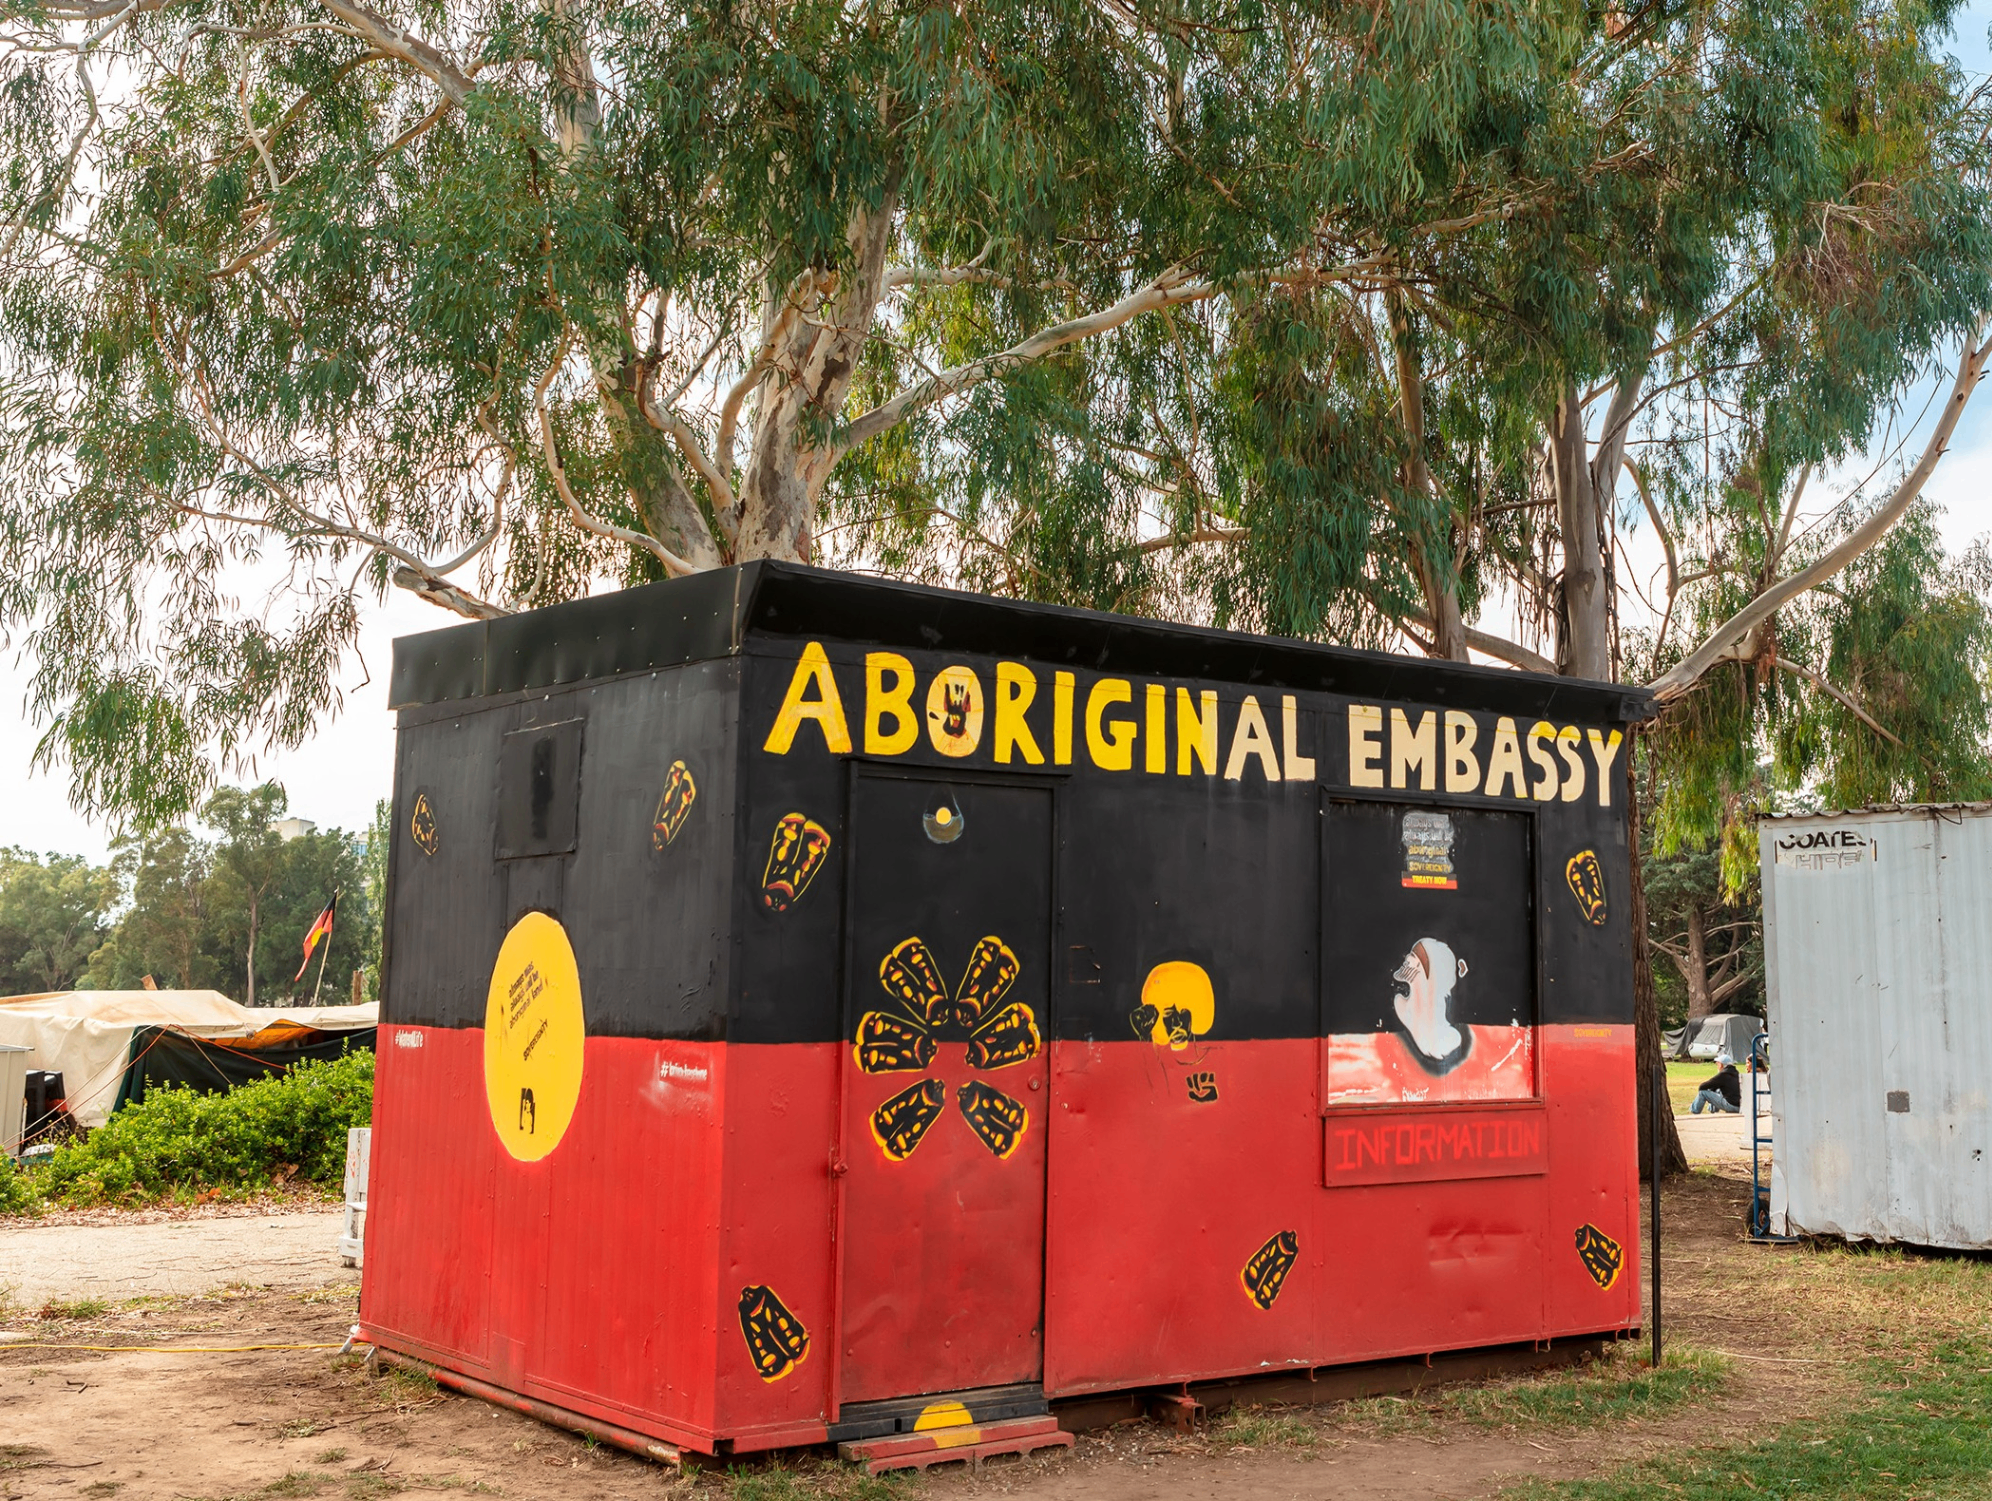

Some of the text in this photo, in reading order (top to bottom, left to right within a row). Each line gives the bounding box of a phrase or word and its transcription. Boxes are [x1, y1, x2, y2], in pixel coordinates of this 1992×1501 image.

[763, 641, 1624, 807] ABORIGINAL EMBASSY
[1412, 875, 1447, 886] TREATY NOW
[1335, 1120, 1540, 1170] INFORMATION
